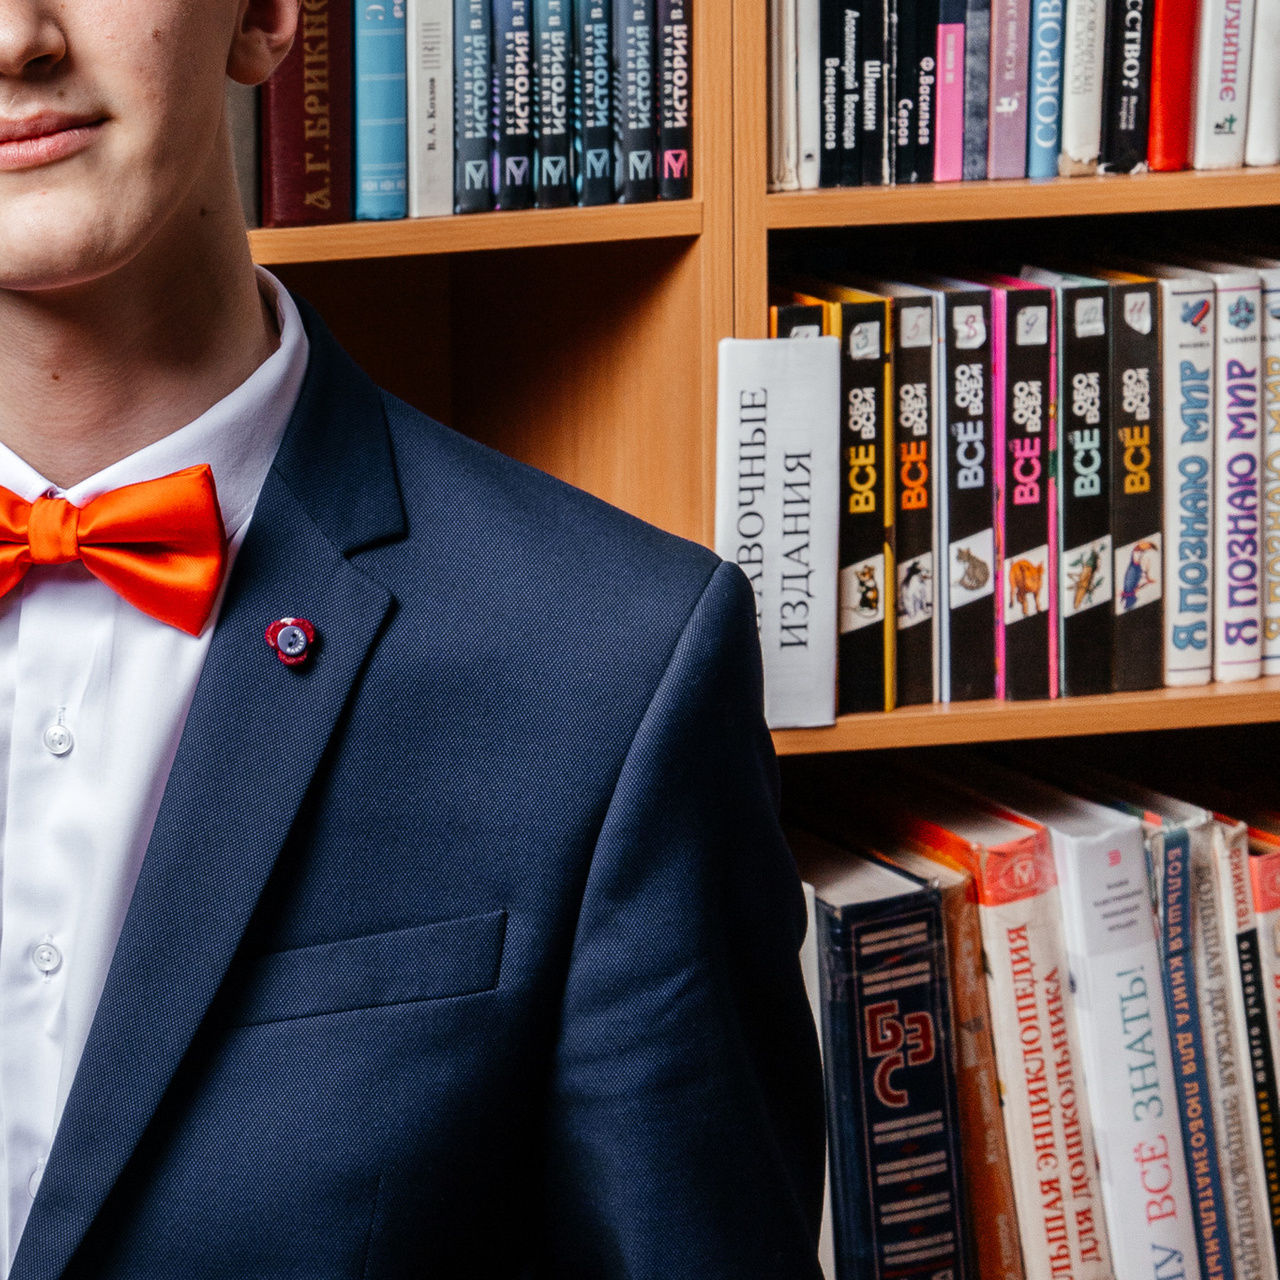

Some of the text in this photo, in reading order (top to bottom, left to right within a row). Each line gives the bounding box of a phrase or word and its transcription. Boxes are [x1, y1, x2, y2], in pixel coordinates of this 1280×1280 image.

[780, 452, 813, 649] ИЗДАНИЯ
[1173, 361, 1209, 650] Я ПОЗНАЮ МИР
[1224, 360, 1259, 645] Я ПОЗНАЮ МИР
[1007, 926, 1056, 1170] ЭНЦИКЛОПЕДИЯ
[1044, 967, 1102, 1263] ДЛЯ ДОШКОЛЬНИКА
[1115, 965, 1164, 1120] ЗНАТЬ!
[1135, 1135, 1178, 1225] ВСЁ
